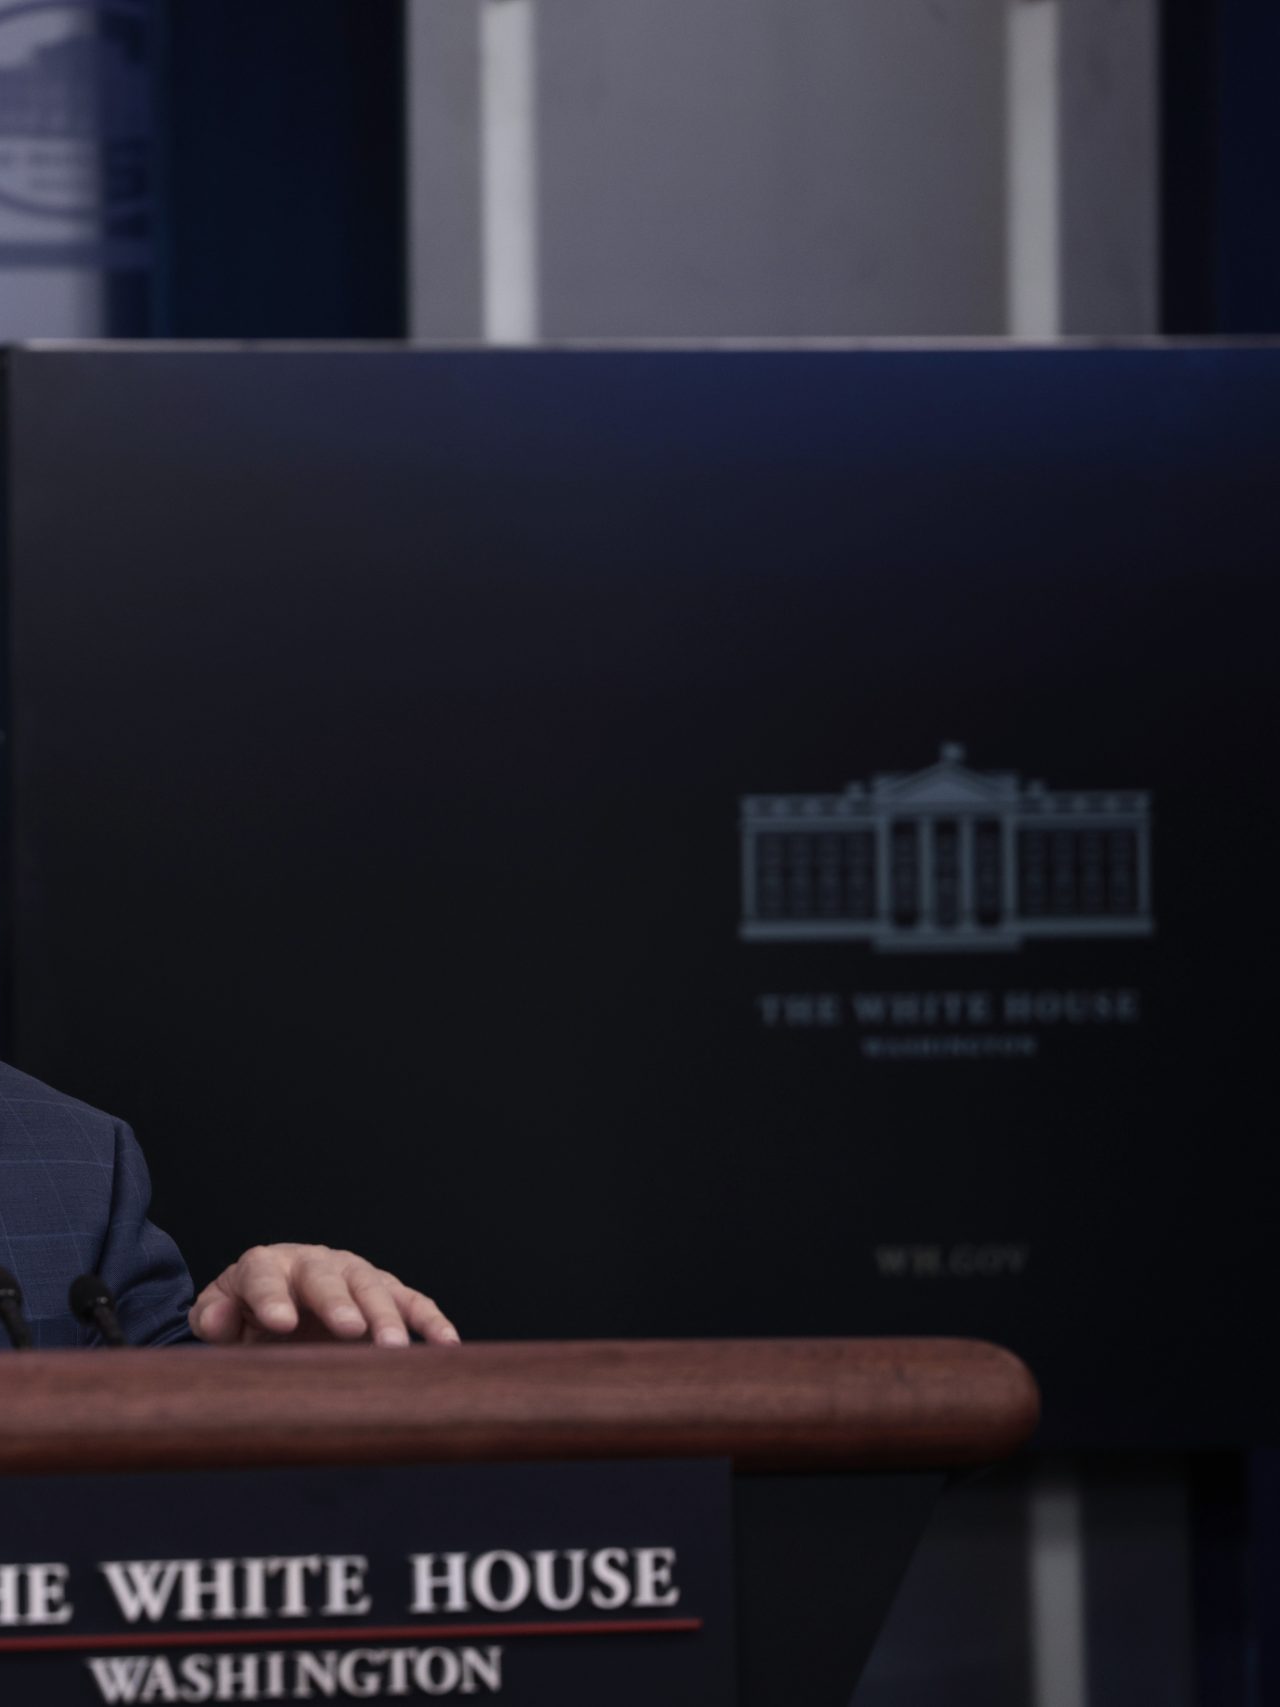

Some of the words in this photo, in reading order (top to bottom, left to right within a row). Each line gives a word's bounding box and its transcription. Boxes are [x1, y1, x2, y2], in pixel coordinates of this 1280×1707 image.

[756, 991, 840, 1026] THE
[853, 989, 991, 1025] WHITE
[1003, 987, 1139, 1024] HOUSE
[101, 1555, 370, 1621] WHITE
[410, 1547, 680, 1614] HOUSE
[87, 1646, 503, 1704] WASHINGTON
